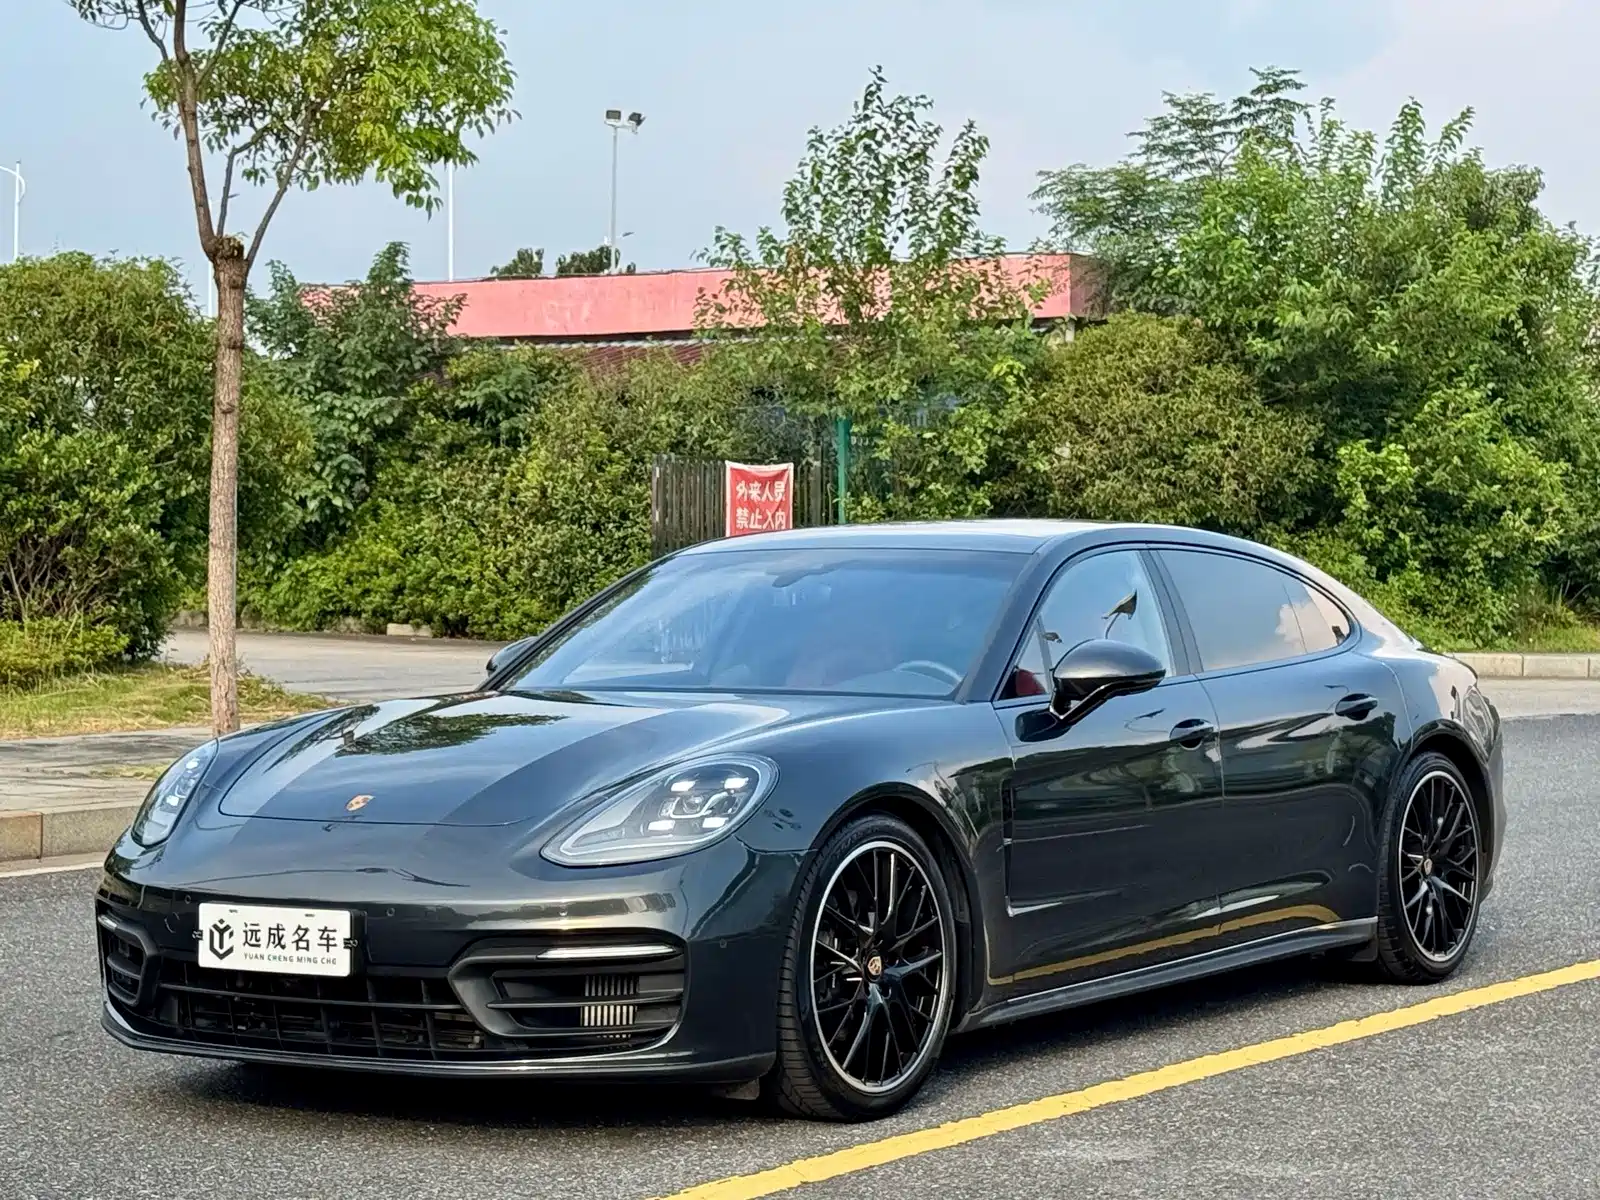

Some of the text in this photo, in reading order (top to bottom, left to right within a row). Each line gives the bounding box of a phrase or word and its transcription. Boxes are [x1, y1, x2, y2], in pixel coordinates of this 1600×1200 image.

[736, 480, 785, 502] 外来人员
[736, 507, 786, 530] 禁止入内
[243, 922, 337, 952] 远成名车
[244, 952, 265, 961] YUAN
[267, 954, 294, 963] CHENG
[296, 955, 318, 965] MING
